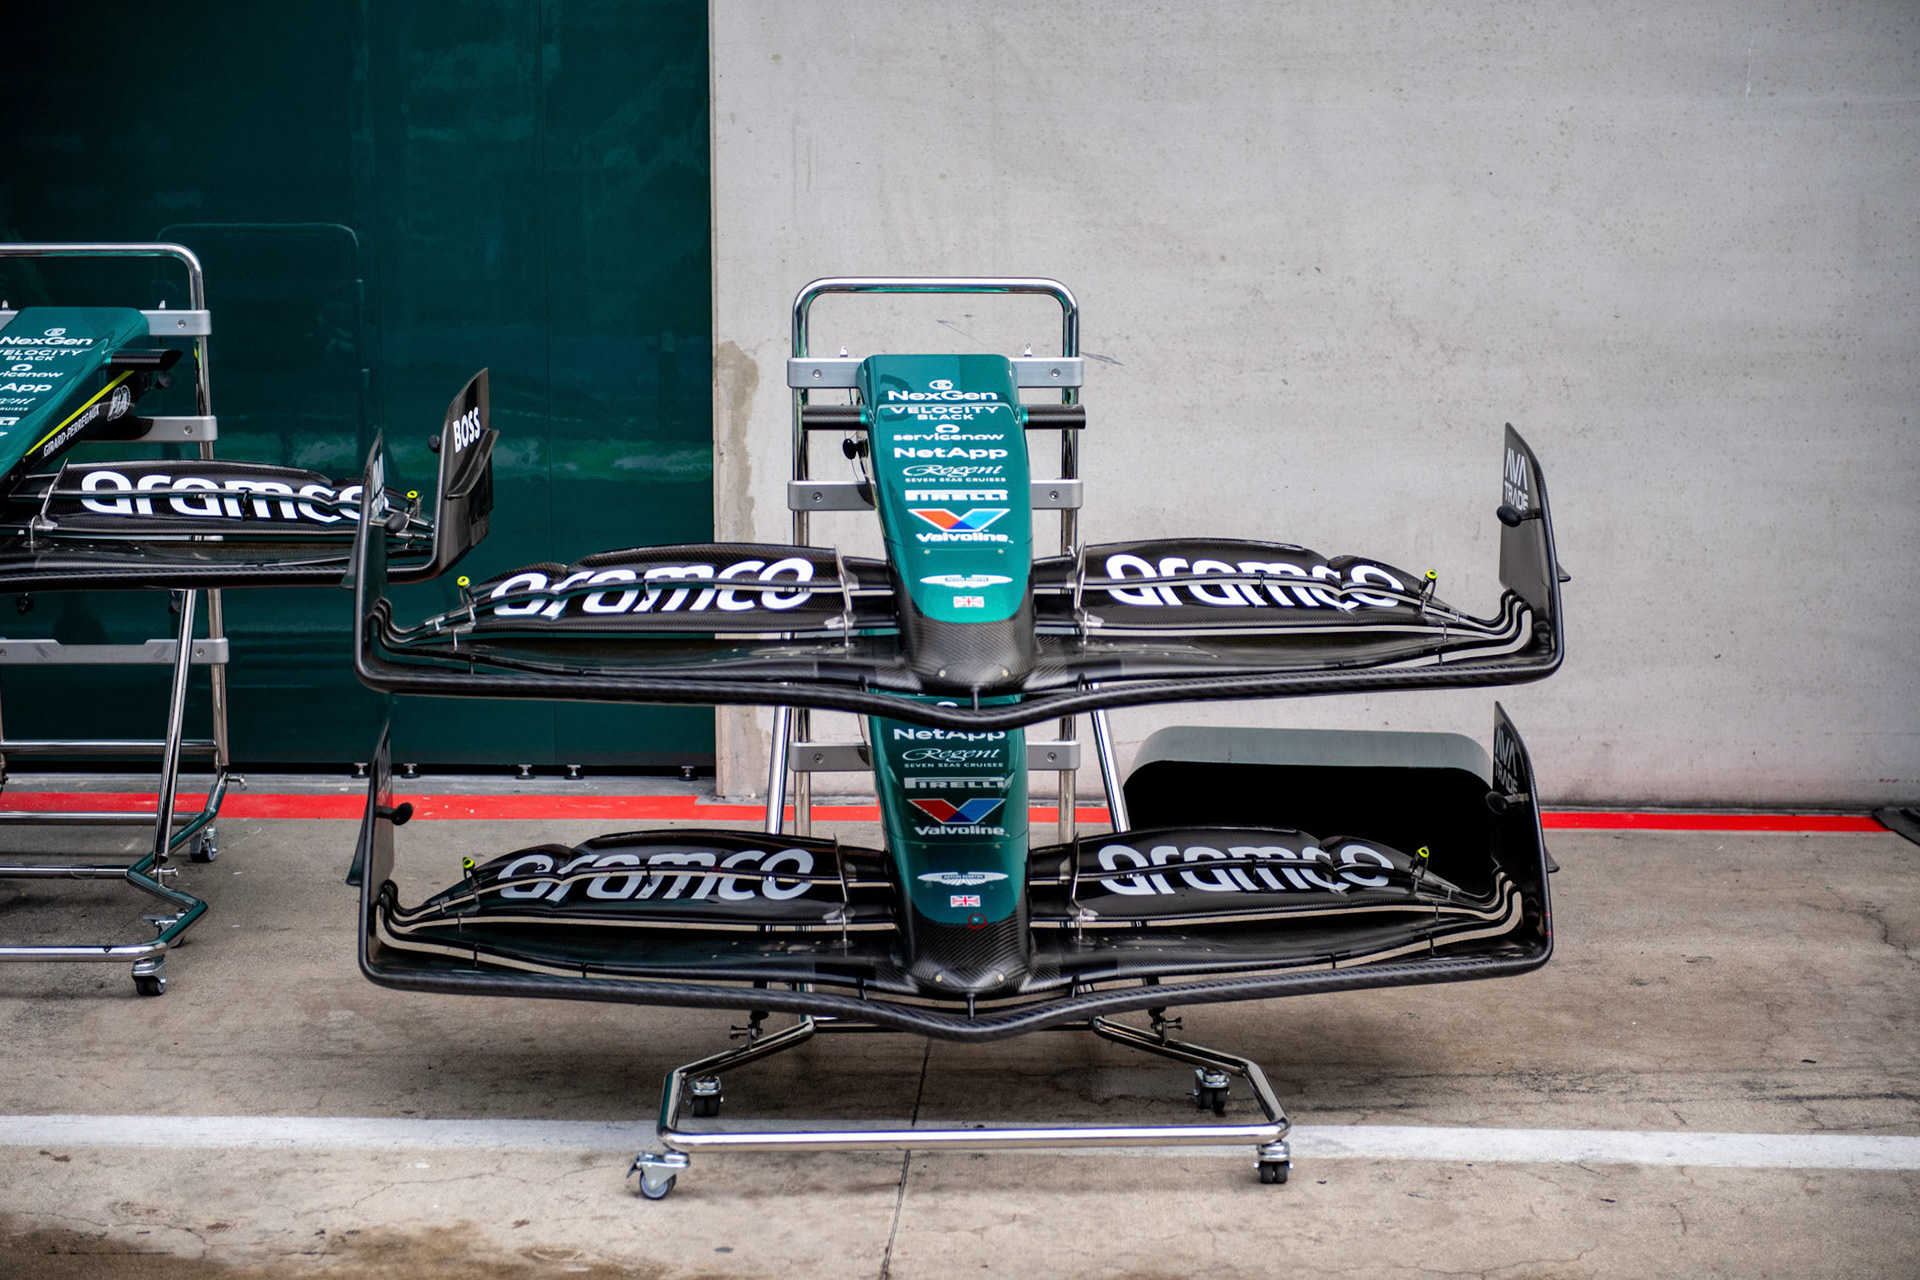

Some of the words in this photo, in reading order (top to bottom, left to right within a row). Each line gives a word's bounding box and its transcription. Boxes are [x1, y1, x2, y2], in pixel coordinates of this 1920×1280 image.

[0, 336, 93, 345] NexGen
[0, 382, 52, 393] App
[888, 390, 998, 400] NexGen
[890, 406, 999, 414] VELOCITY
[453, 406, 481, 453] BOSS
[894, 447, 1008, 459] NetApp
[902, 464, 1004, 478] Regent
[81, 471, 390, 523] aramco
[904, 489, 1008, 501] PIRELLI
[1504, 480, 1529, 511] TRADE
[915, 532, 1009, 542] Valvoline
[490, 557, 815, 620] aramco
[1105, 554, 1405, 611] aramco
[893, 728, 1006, 742] NetApp
[902, 747, 1001, 762] Regent
[1494, 755, 1518, 795] TRADE
[904, 777, 1005, 789] PIRELLI
[914, 825, 1005, 836] Valvoline
[498, 848, 815, 903] aramco
[1098, 844, 1395, 897] aramco
